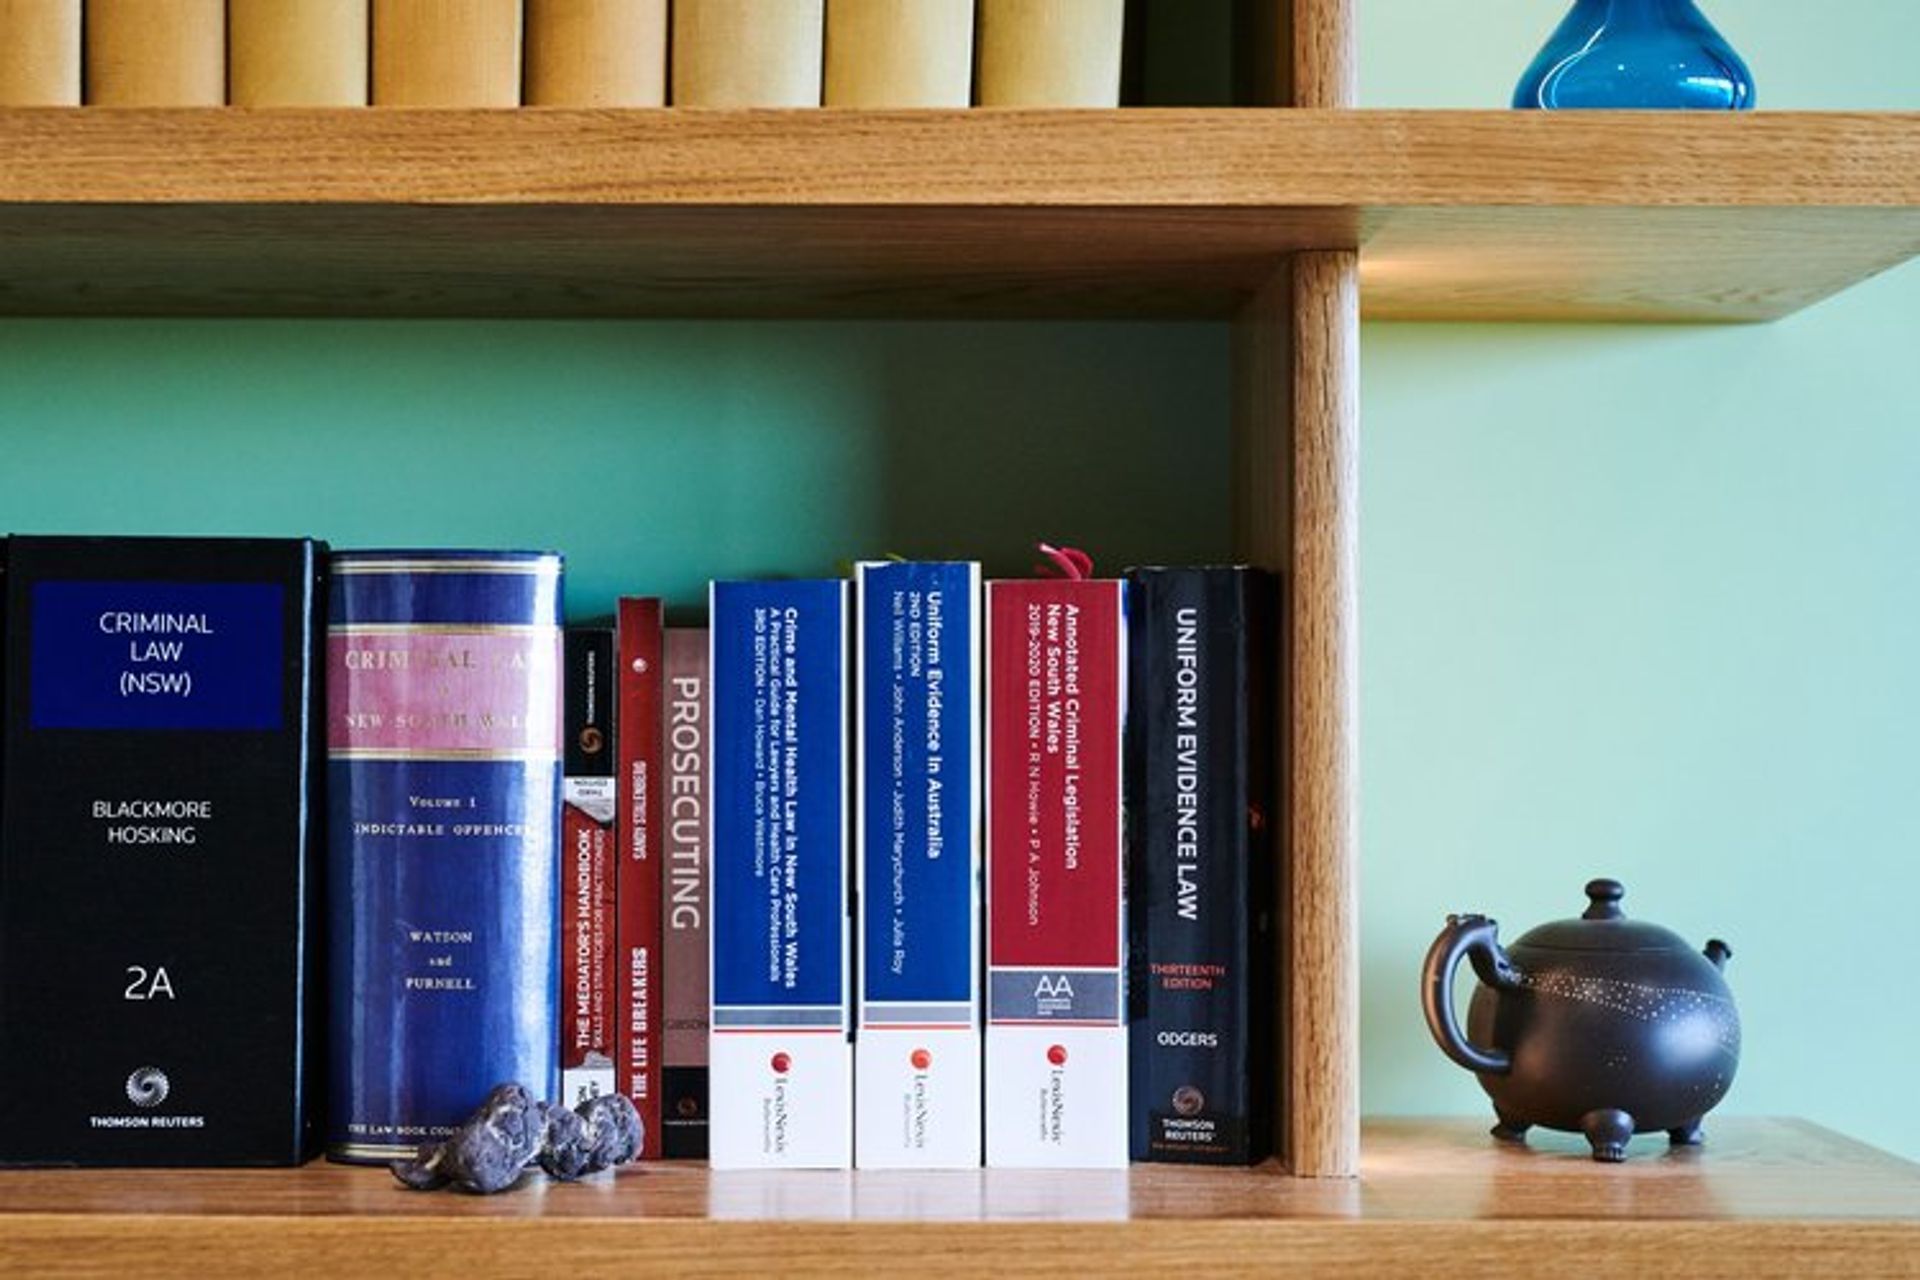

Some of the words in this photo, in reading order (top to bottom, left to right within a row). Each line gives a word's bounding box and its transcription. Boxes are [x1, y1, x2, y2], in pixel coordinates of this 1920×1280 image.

[754, 608, 767, 633] 3RD
[770, 607, 782, 618] A
[893, 590, 905, 616] Neil
[908, 590, 921, 619] 2ND
[99, 612, 214, 634] CRIMINAL
[785, 607, 798, 654] Crime
[926, 590, 944, 664] Uniform
[1028, 603, 1041, 678] 2019-2020
[1047, 603, 1062, 642] New
[130, 641, 183, 662] LAW
[754, 635, 767, 688] EDITION
[769, 621, 782, 677] Practical
[893, 618, 905, 671] Williams
[908, 621, 921, 678] EDITION
[1065, 603, 1080, 695] Annotated
[119, 671, 192, 697] (NSW)
[785, 657, 798, 687] and
[1047, 645, 1062, 696] South
[1177, 608, 1198, 728] UNIFORM
[754, 699, 767, 721] Dan
[769, 678, 782, 716] Guide
[893, 683, 905, 715] John
[926, 669, 944, 751] Evidence
[1028, 679, 1041, 739] EDITION
[769, 719, 782, 738] for
[785, 691, 798, 743] Mental
[1047, 700, 1062, 754] Wales
[1065, 699, 1080, 769] Criminal
[754, 725, 767, 770] Howard
[767, 741, 782, 792] Lawyers
[893, 717, 905, 778] Anderson
[1028, 752, 1041, 763] R
[785, 747, 798, 797] Health
[1028, 766, 1041, 777] N
[92, 801, 212, 818] BLACKMORE
[672, 677, 700, 929] PROSECUTING
[754, 780, 767, 816] Bruce
[769, 795, 782, 819] and
[893, 790, 905, 830] Judith
[1028, 780, 1041, 825] Howie
[1177, 734, 1198, 858] EVIDENCE
[107, 827, 196, 844] HOSKING
[353, 823, 444, 836] INDICTABLE
[785, 801, 798, 832] Law
[926, 778, 944, 860] Australia
[1062, 774, 1080, 870] Legislation
[754, 817, 767, 877] Westmore
[769, 822, 782, 863] Health
[1028, 838, 1041, 849] P
[1028, 852, 1041, 864] A
[577, 829, 591, 917] HANDBOOK
[769, 866, 782, 897] Care
[785, 854, 798, 889] New
[891, 831, 905, 906] Marychurch
[1028, 867, 1041, 926] Johnson
[1177, 864, 1198, 921] LAW
[785, 892, 798, 938] South
[893, 918, 905, 947] Julia
[408, 931, 473, 944] WATSON
[769, 898, 782, 982] Professionals
[429, 956, 453, 967] and
[577, 921, 591, 1015] MEDIATOR'S
[785, 942, 798, 989] Wales
[891, 949, 905, 975] Roy
[1150, 964, 1226, 976] THIRTEENTH
[124, 965, 175, 1000] 2A
[405, 978, 477, 990] PURNELL
[632, 947, 648, 1031] BREAKERS
[1163, 977, 1213, 990] EDITION
[577, 1018, 591, 1048] THE
[1157, 1031, 1218, 1047] ODGERS
[632, 1038, 648, 1068] LIFE
[632, 1073, 648, 1100] THE
[90, 1116, 149, 1128] THOMSON
[151, 1116, 205, 1128] REUTERS
[914, 1074, 929, 1149] LexisNexis
[1052, 1069, 1065, 1143] LexisNexis
[1162, 1118, 1216, 1131] THOMSON
[369, 1125, 392, 1136] LAW
[396, 1126, 428, 1137] BOOK
[1164, 1129, 1213, 1142] REUTERS
